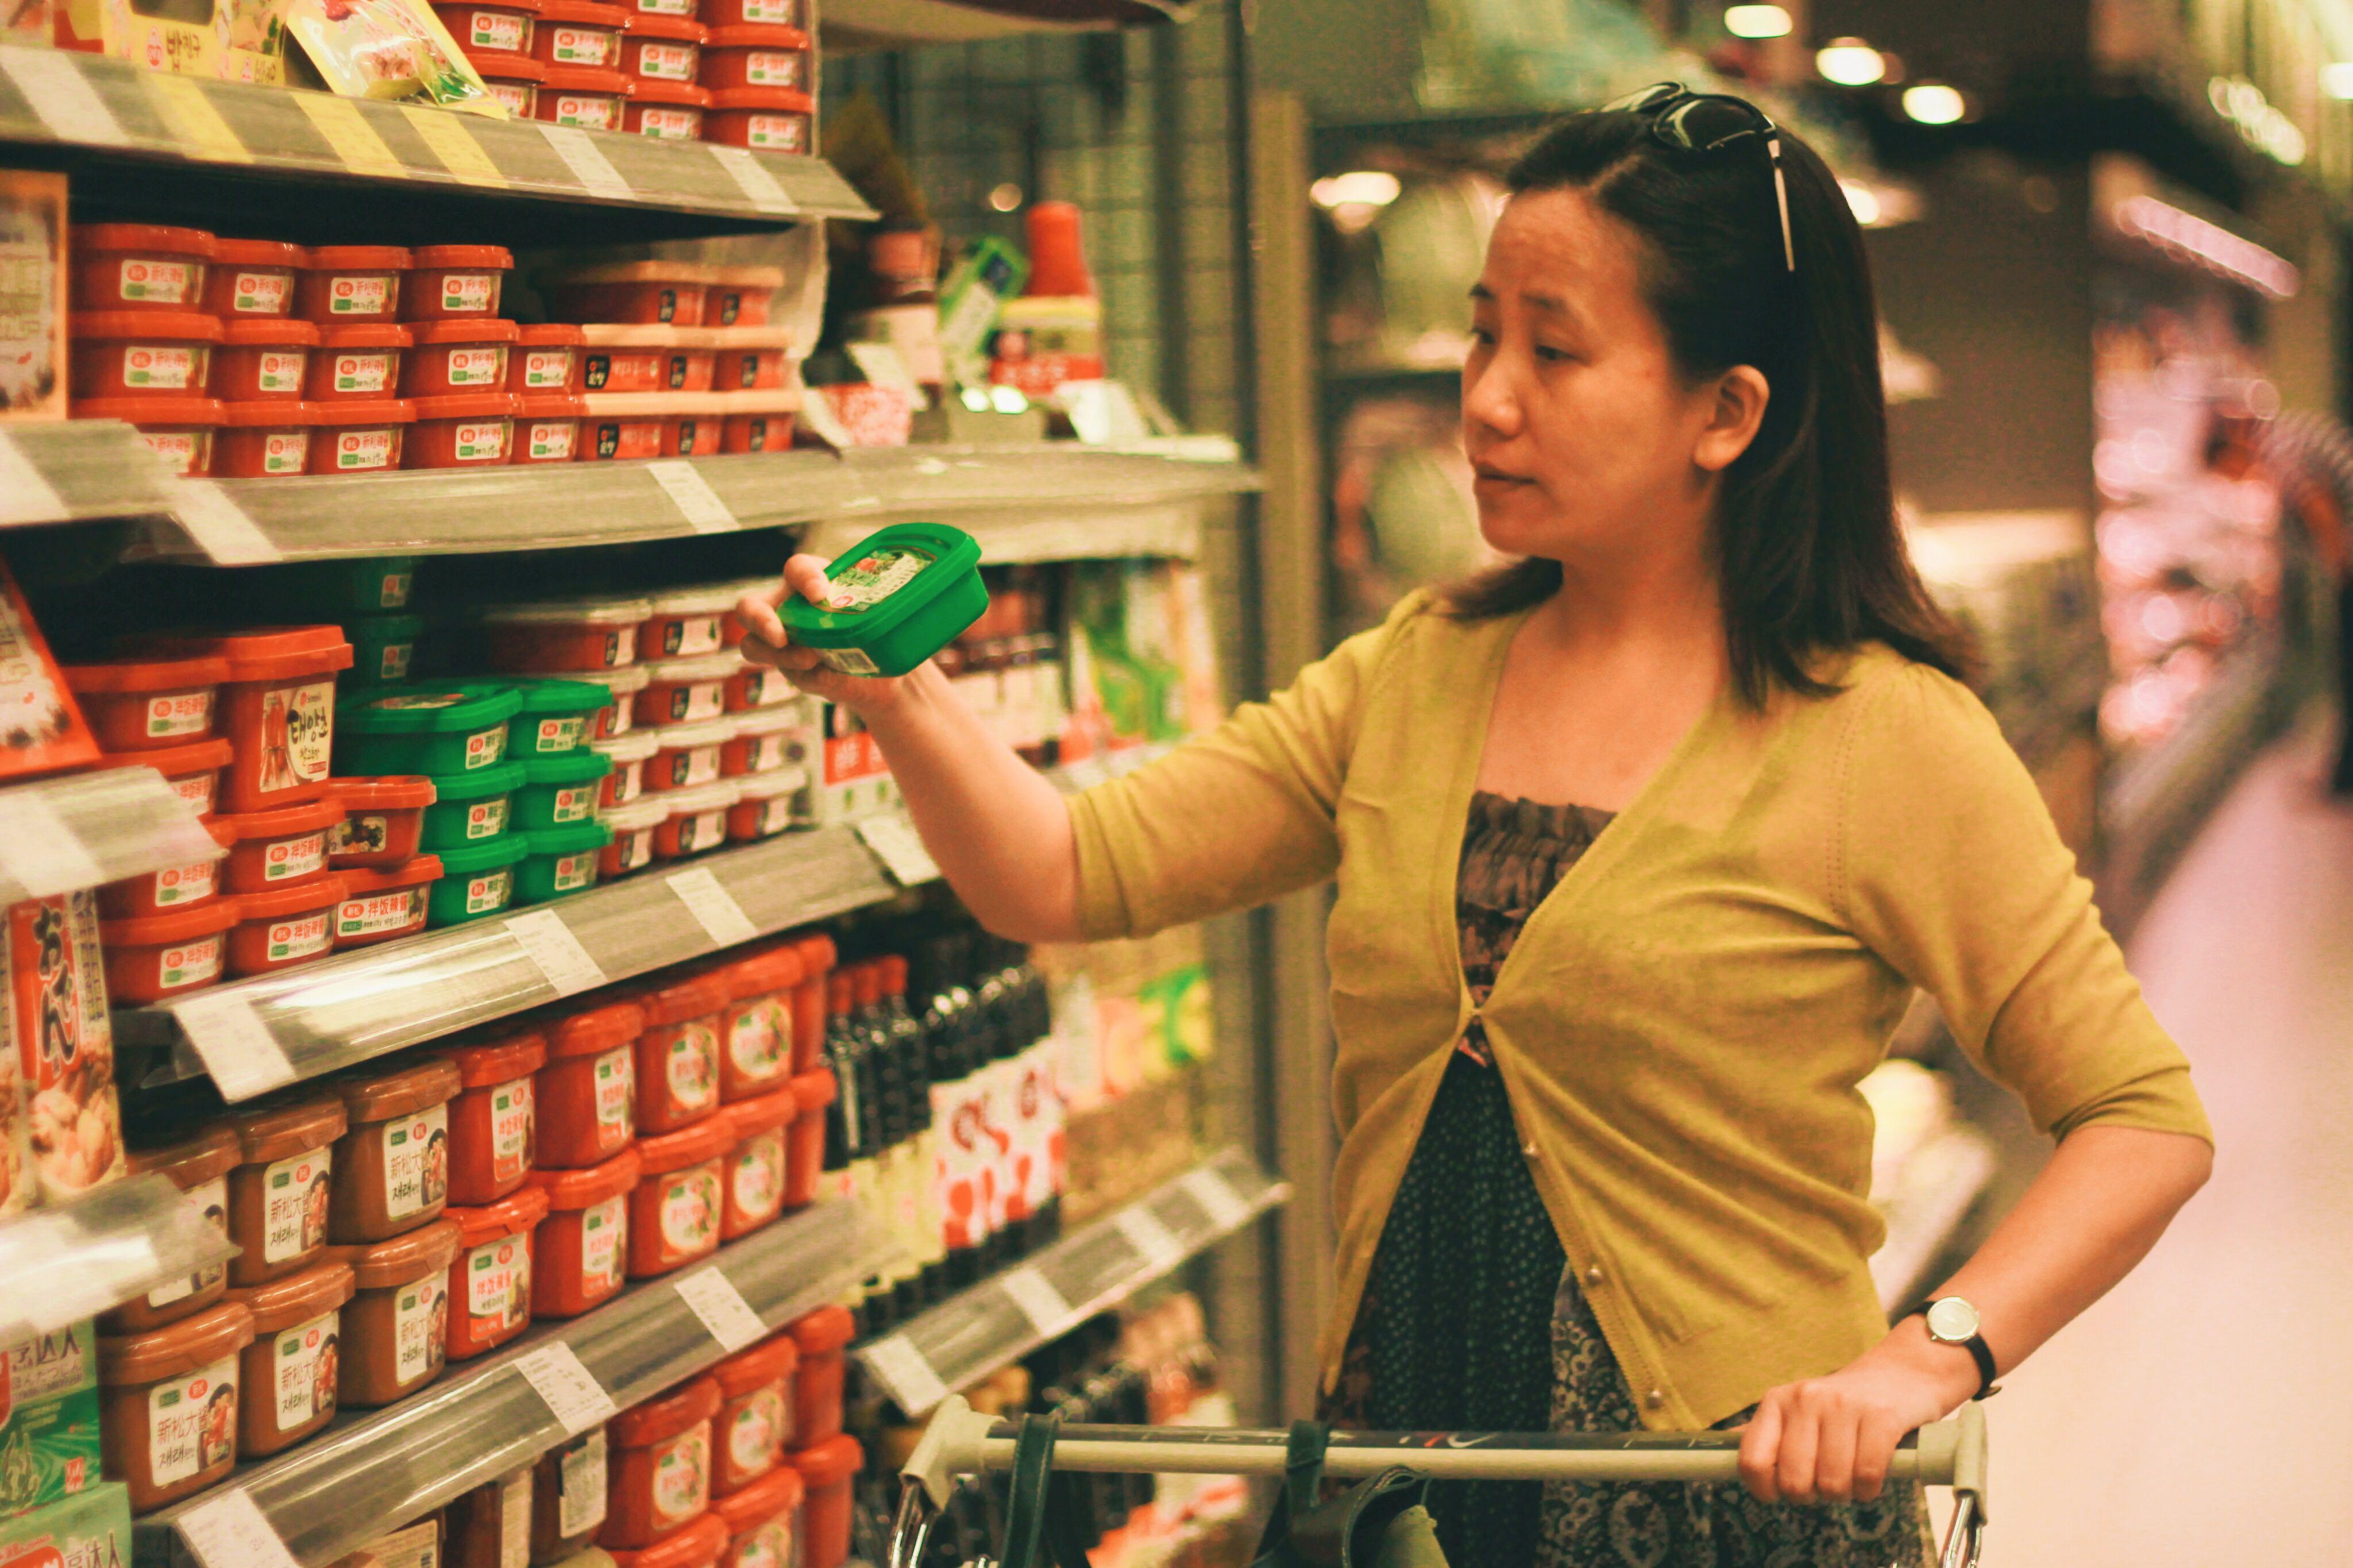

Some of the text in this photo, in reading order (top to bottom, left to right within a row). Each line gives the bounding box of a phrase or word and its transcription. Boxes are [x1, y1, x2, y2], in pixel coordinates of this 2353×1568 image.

[288, 705, 329, 746] 태양초
[392, 1179, 411, 1202] 재래
[270, 1223, 291, 1248] 재래
[281, 1388, 302, 1415] 재래
[158, 1440, 184, 1470] 재래
